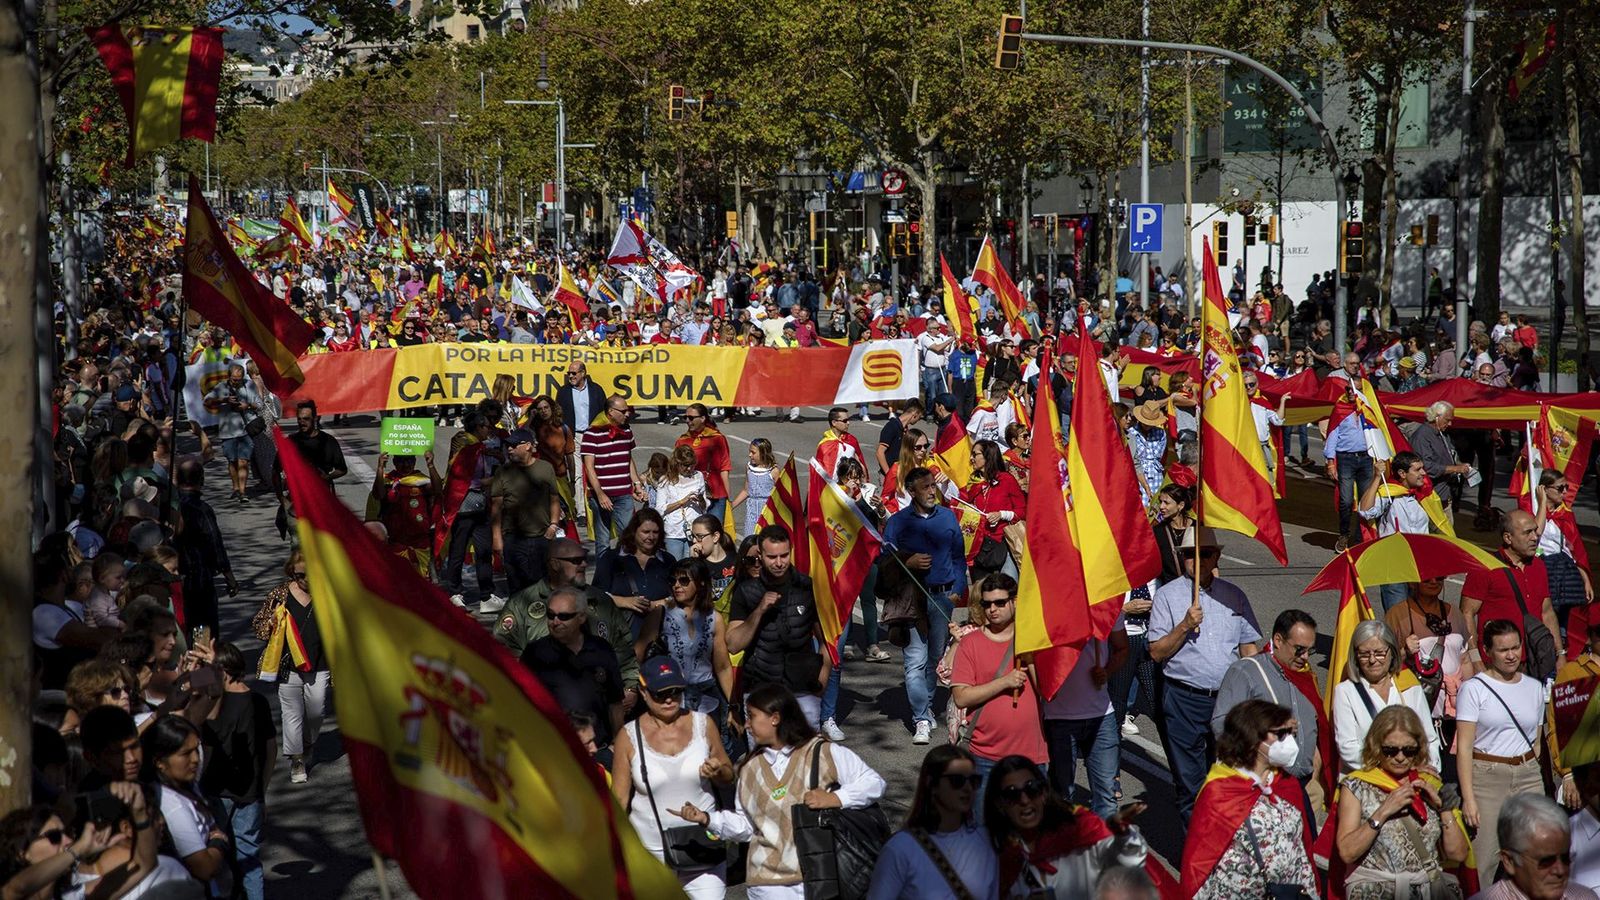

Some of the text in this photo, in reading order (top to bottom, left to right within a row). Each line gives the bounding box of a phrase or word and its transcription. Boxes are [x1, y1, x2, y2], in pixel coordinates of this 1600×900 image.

[1136, 207, 1157, 233] P
[446, 347, 670, 364] POR LA HISPANIDAD
[398, 365, 723, 402] CATAUÑ SUMA
[1555, 684, 1576, 698] 12 de
[1555, 692, 1590, 708] octubre
